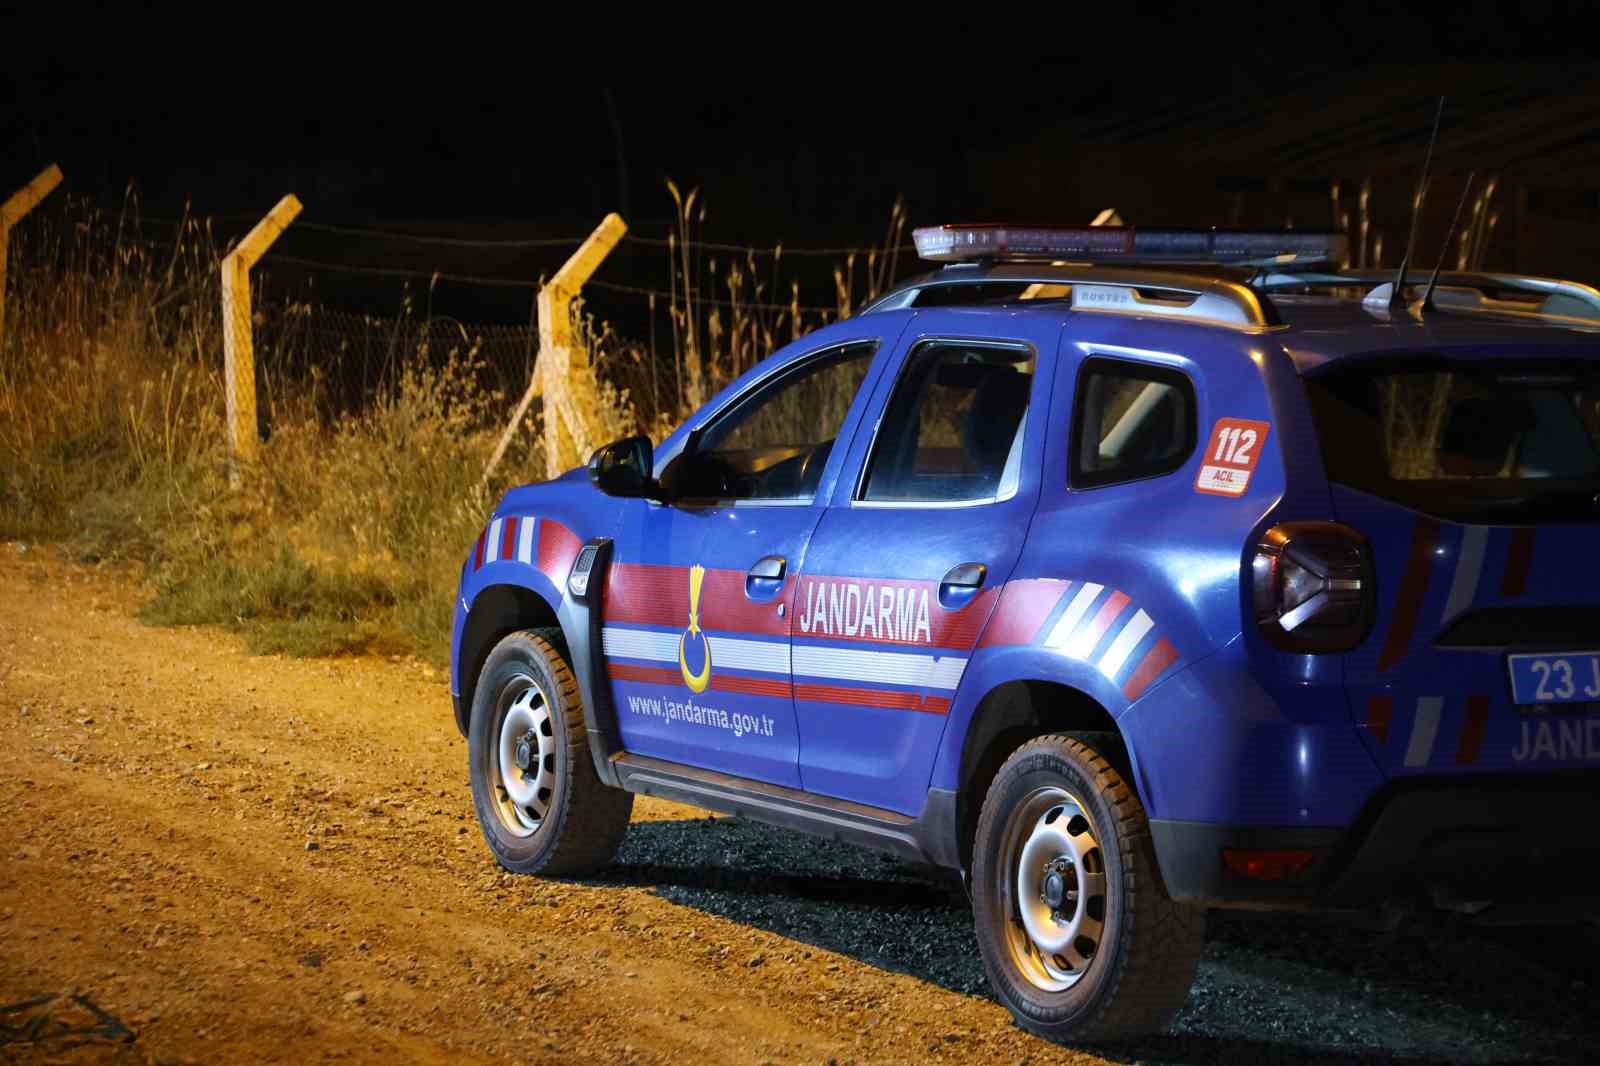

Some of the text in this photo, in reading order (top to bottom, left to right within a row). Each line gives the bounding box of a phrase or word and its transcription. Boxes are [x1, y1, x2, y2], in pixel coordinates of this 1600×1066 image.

[1214, 427, 1257, 465] 112
[800, 582, 932, 643] JANDARMA
[1531, 659, 1575, 701] 23
[628, 695, 775, 737] www.jandarma.gov.tr
